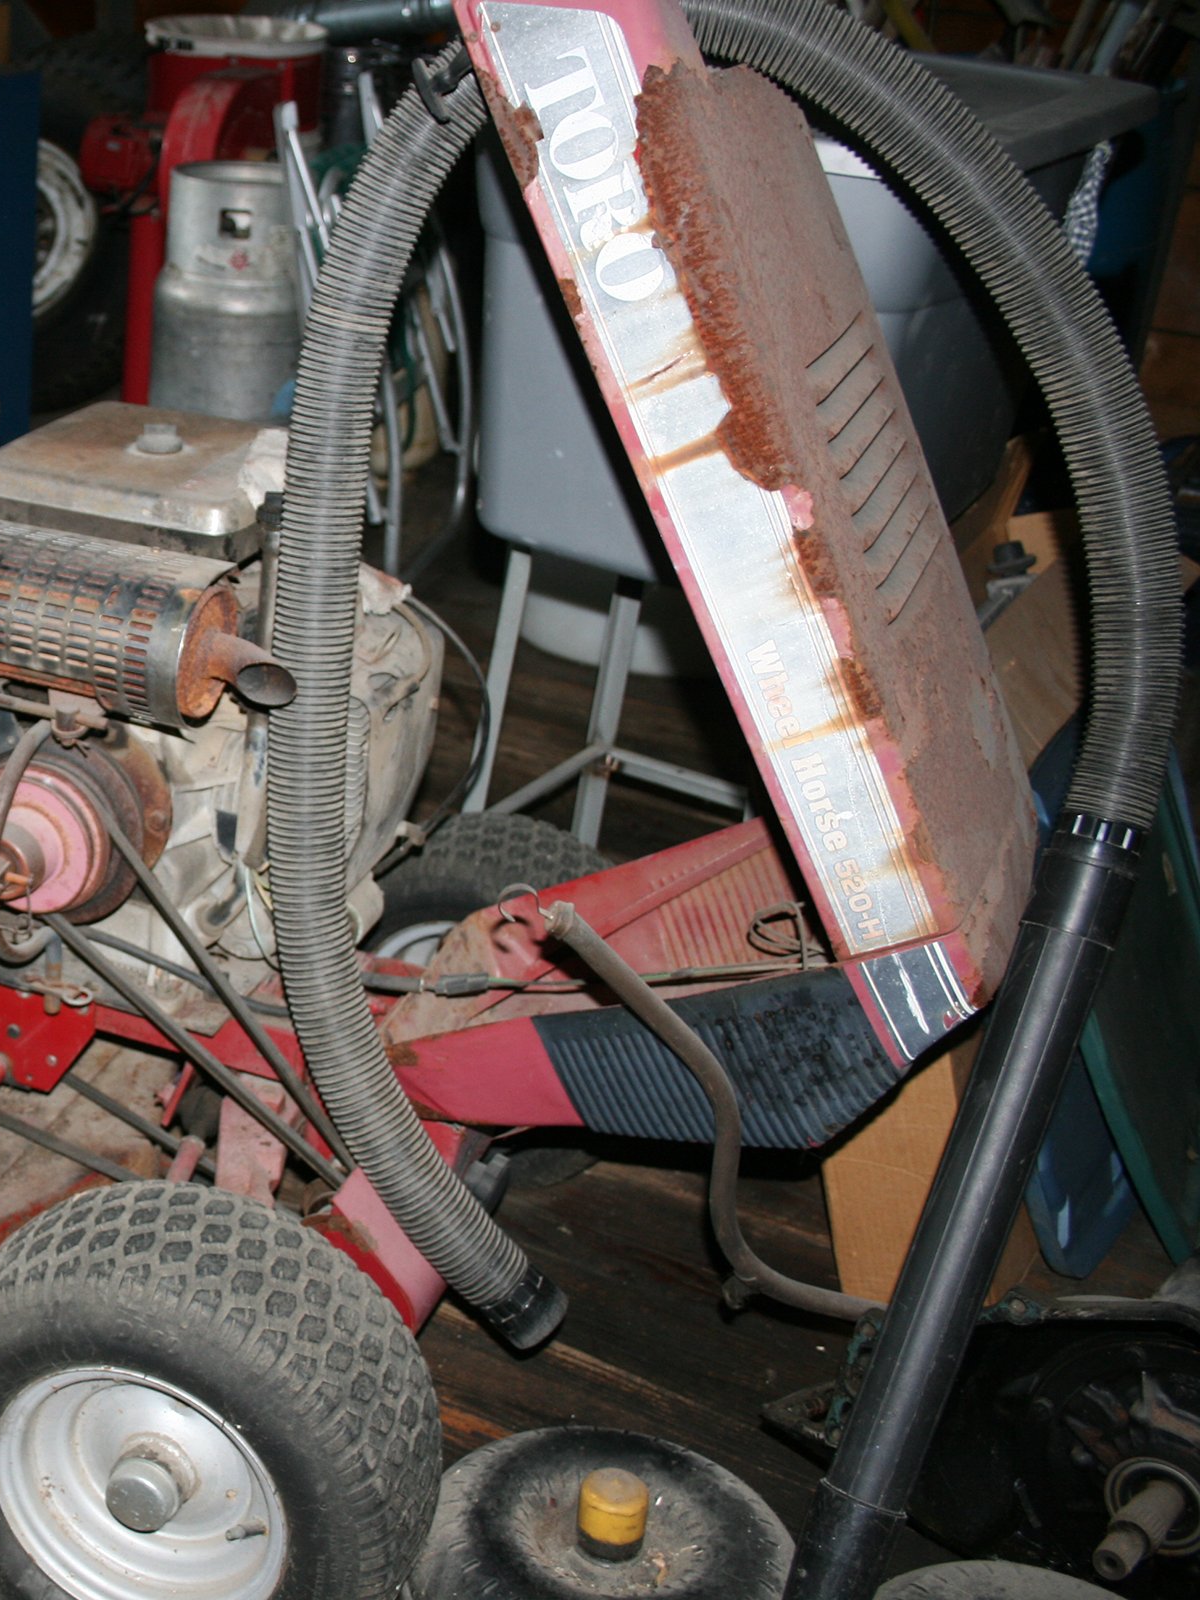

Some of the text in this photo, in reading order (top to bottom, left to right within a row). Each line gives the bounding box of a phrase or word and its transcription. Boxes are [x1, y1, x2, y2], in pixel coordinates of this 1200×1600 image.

[524, 46, 665, 301] TORO
[746, 640, 884, 941] Wheel Horse 520-H
